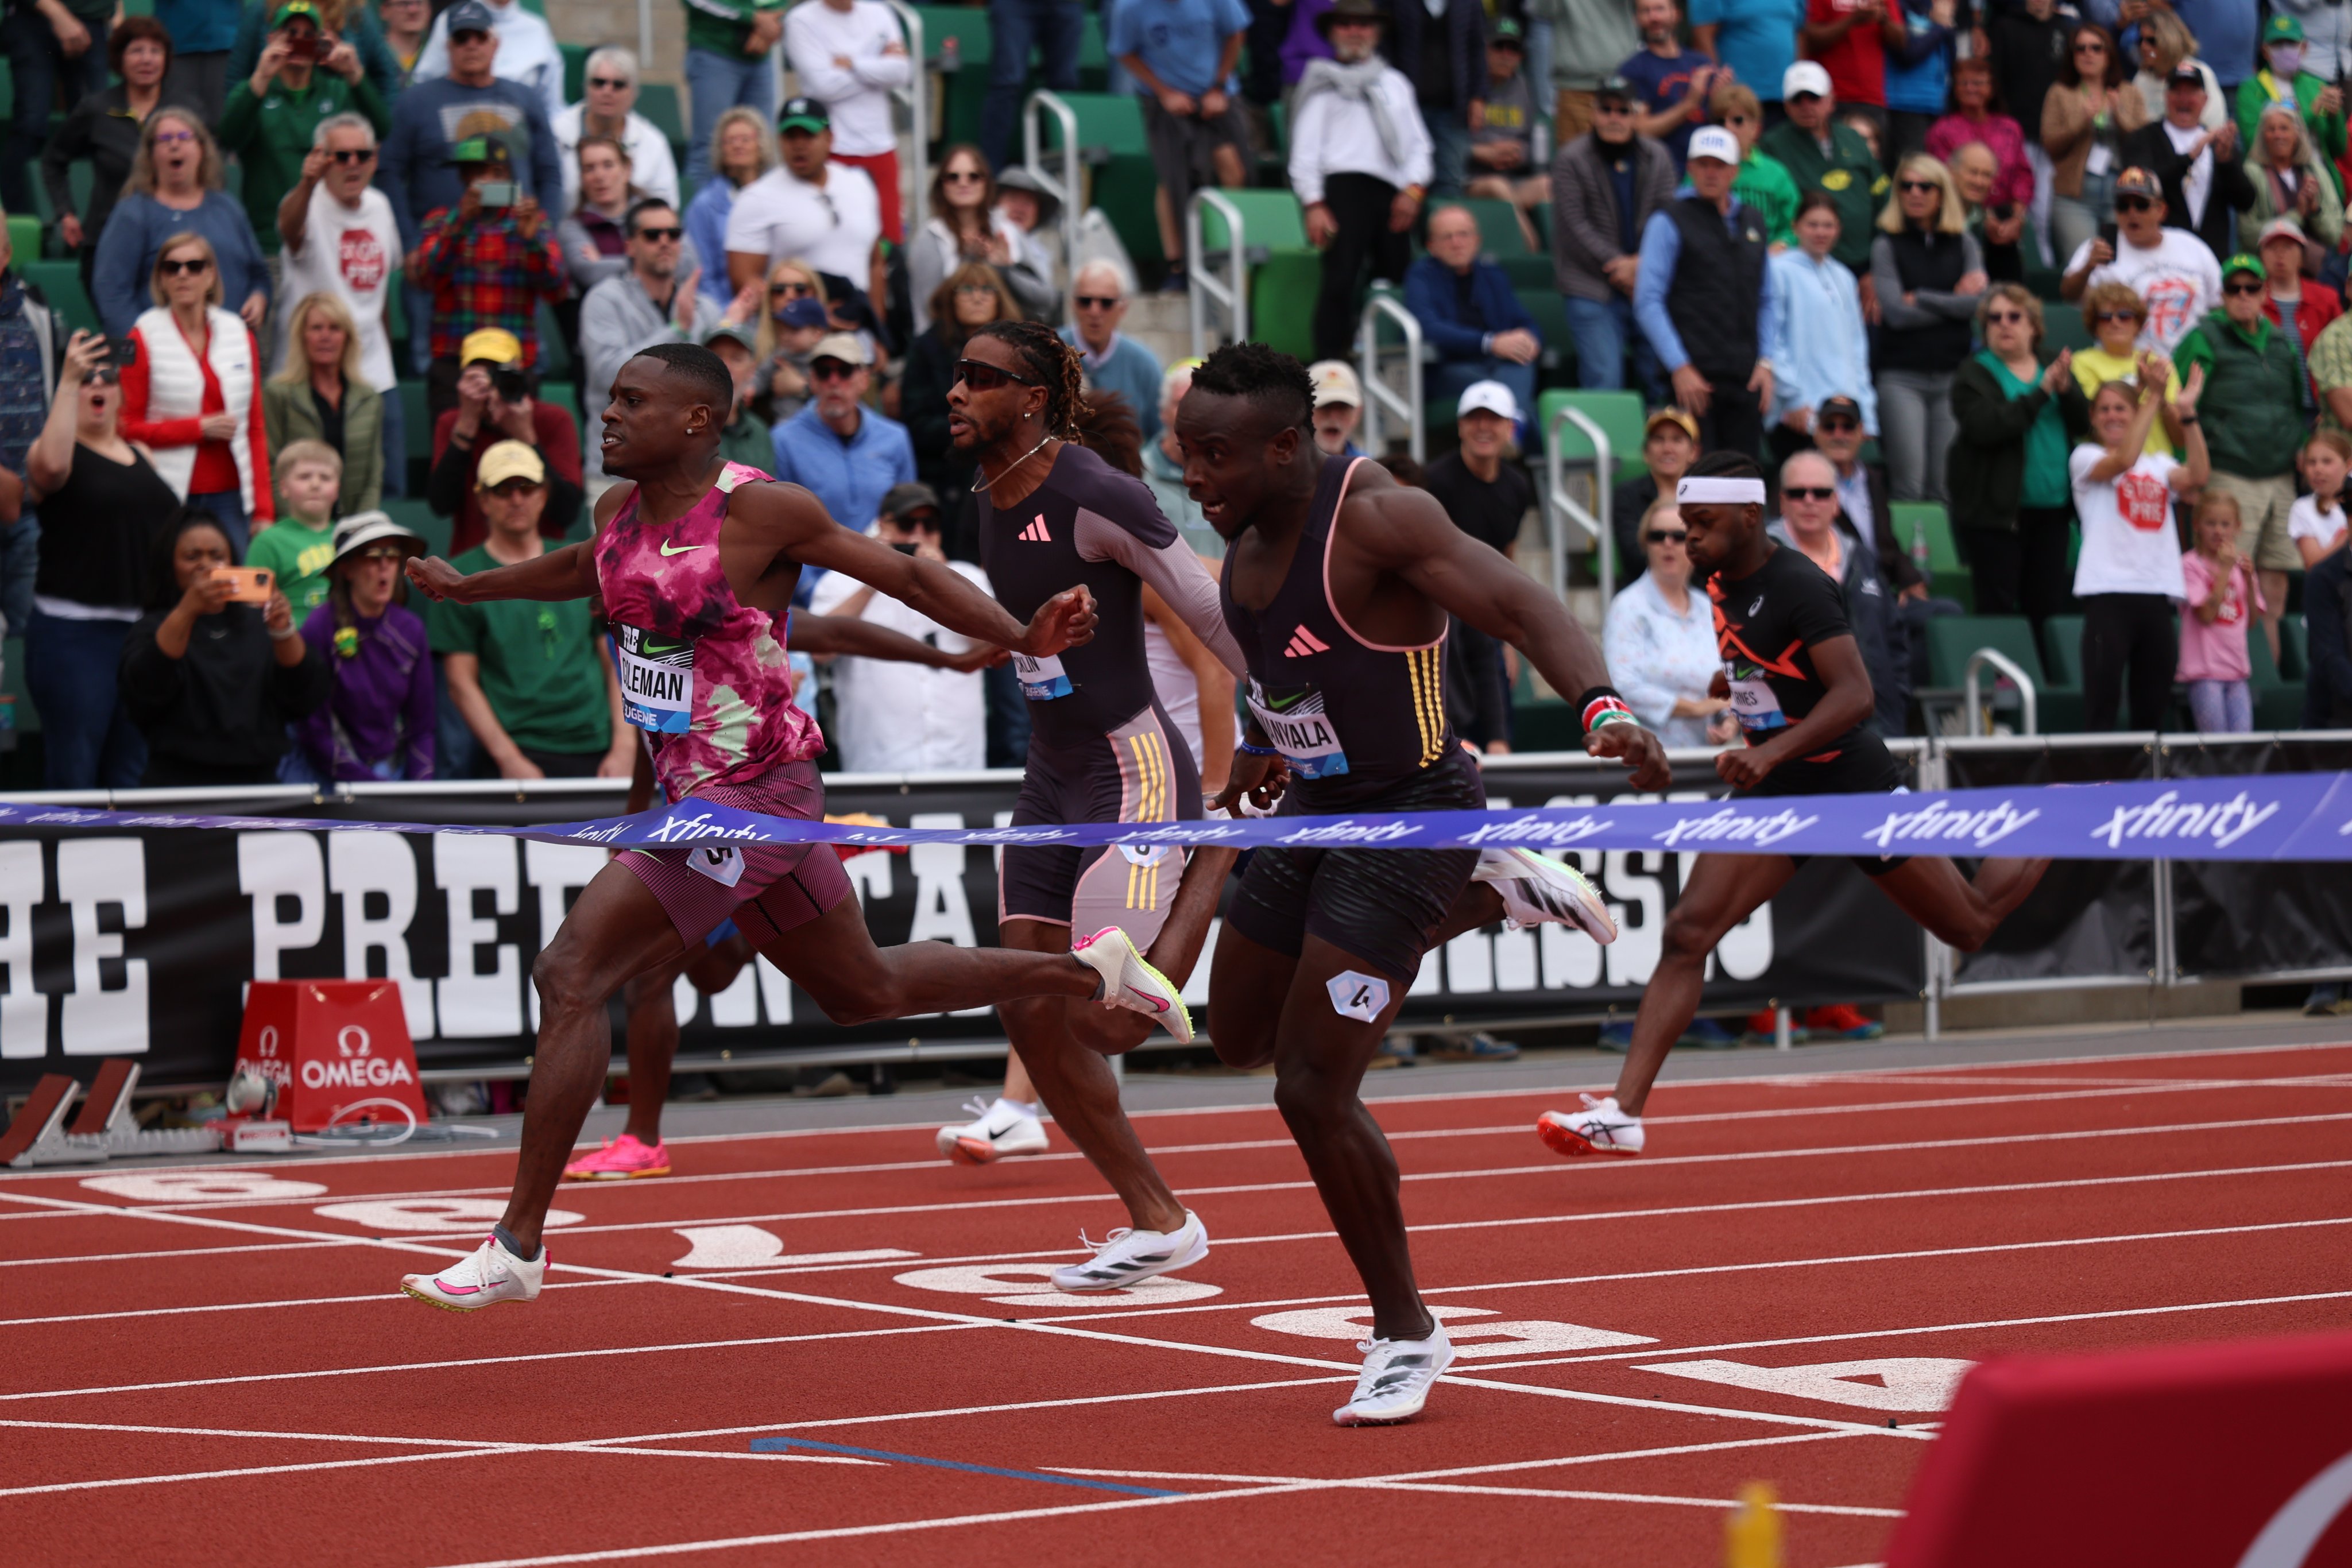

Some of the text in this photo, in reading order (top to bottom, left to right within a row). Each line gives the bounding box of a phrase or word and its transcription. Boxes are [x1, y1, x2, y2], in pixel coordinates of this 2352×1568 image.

[1275, 820, 1424, 843] xfinity
[1457, 814, 1614, 845] xfinity
[1651, 807, 1819, 847] xfinity
[1862, 799, 2041, 848] xfinity
[2089, 790, 2280, 849] xfinity
[301, 1058, 413, 1089] OMEGA
